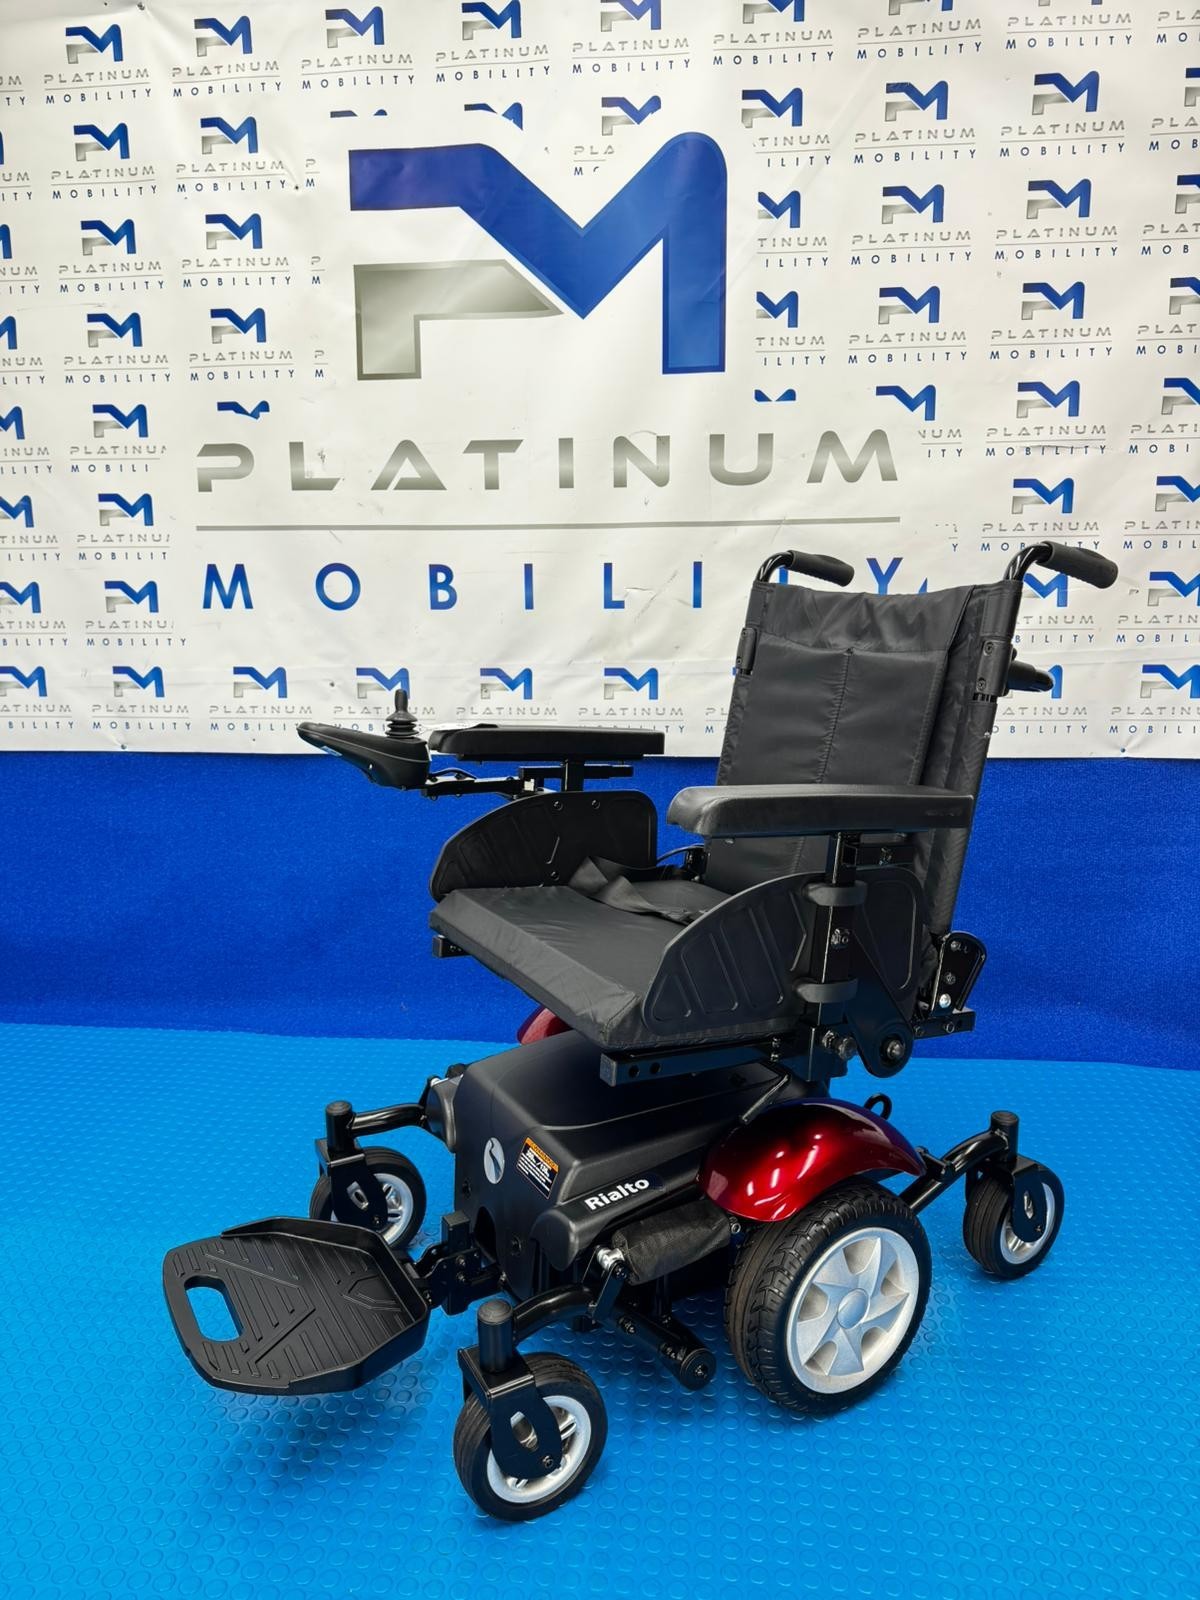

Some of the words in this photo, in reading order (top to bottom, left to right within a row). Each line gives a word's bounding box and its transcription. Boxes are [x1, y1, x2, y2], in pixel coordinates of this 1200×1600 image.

[1008, 13, 1131, 26] PLATINUM
[856, 19, 983, 39] PLATINUM
[713, 29, 832, 44] PLATINUM
[1005, 35, 1132, 51] MOBILITY
[573, 38, 689, 52] PLATINUM
[857, 41, 982, 59] MOBILITY
[436, 44, 548, 62] PLATINUM
[713, 51, 834, 66] MOBILITY
[301, 54, 412, 69] PLATINUM
[572, 59, 690, 74] MOBILITY
[44, 68, 149, 84] PLATINUM
[172, 61, 279, 77] PLATINUM
[436, 65, 550, 83] MOBILITY
[302, 75, 414, 89] MOBILITY
[46, 88, 151, 104] MOBILITY
[173, 82, 281, 97] MOBILITY
[1001, 120, 1125, 136] PLATINUM
[855, 128, 975, 143] PLATINUM
[854, 149, 976, 164] MOBILITY
[1000, 142, 1125, 157] MOBILITY
[51, 165, 155, 180] PLATINUM
[176, 160, 285, 176] PLATINUM
[52, 185, 156, 199] MOBILITY
[177, 180, 285, 192] MOBILITY
[852, 231, 971, 245] PLATINUM
[996, 226, 1117, 239] PLATINUM
[851, 251, 971, 265] MOBILITY
[994, 247, 1118, 262] MOBILITY
[59, 261, 161, 274] PLATINUM
[182, 257, 289, 268] PLATINUM
[60, 280, 164, 293] MOBILITY
[183, 276, 291, 288] MOBILITY
[849, 331, 966, 344] PLATINUM
[991, 327, 1111, 339] PLATINUM
[64, 355, 168, 365] PLATINUM
[189, 351, 292, 362] PLATINUM
[848, 351, 967, 364] MOBILITY
[990, 347, 1112, 360] MOBILITY
[65, 373, 170, 383] MOBILITY
[190, 369, 294, 381] MOBILITY
[986, 425, 1106, 437] PLATINUM
[986, 445, 1109, 456] MOBILITY
[196, 429, 898, 493] PLATINUM
[981, 521, 1100, 533] PLATINUM
[202, 557, 903, 611] MOBILIY
[87, 638, 186, 646] MOBILITY
[92, 704, 189, 713] PLATINUM
[209, 705, 312, 714] PLATINUM
[456, 707, 557, 715] PLATINUM
[578, 707, 683, 716] PLATINUM
[93, 721, 191, 730] MOBILITY
[584, 1179, 650, 1210] Rialto
